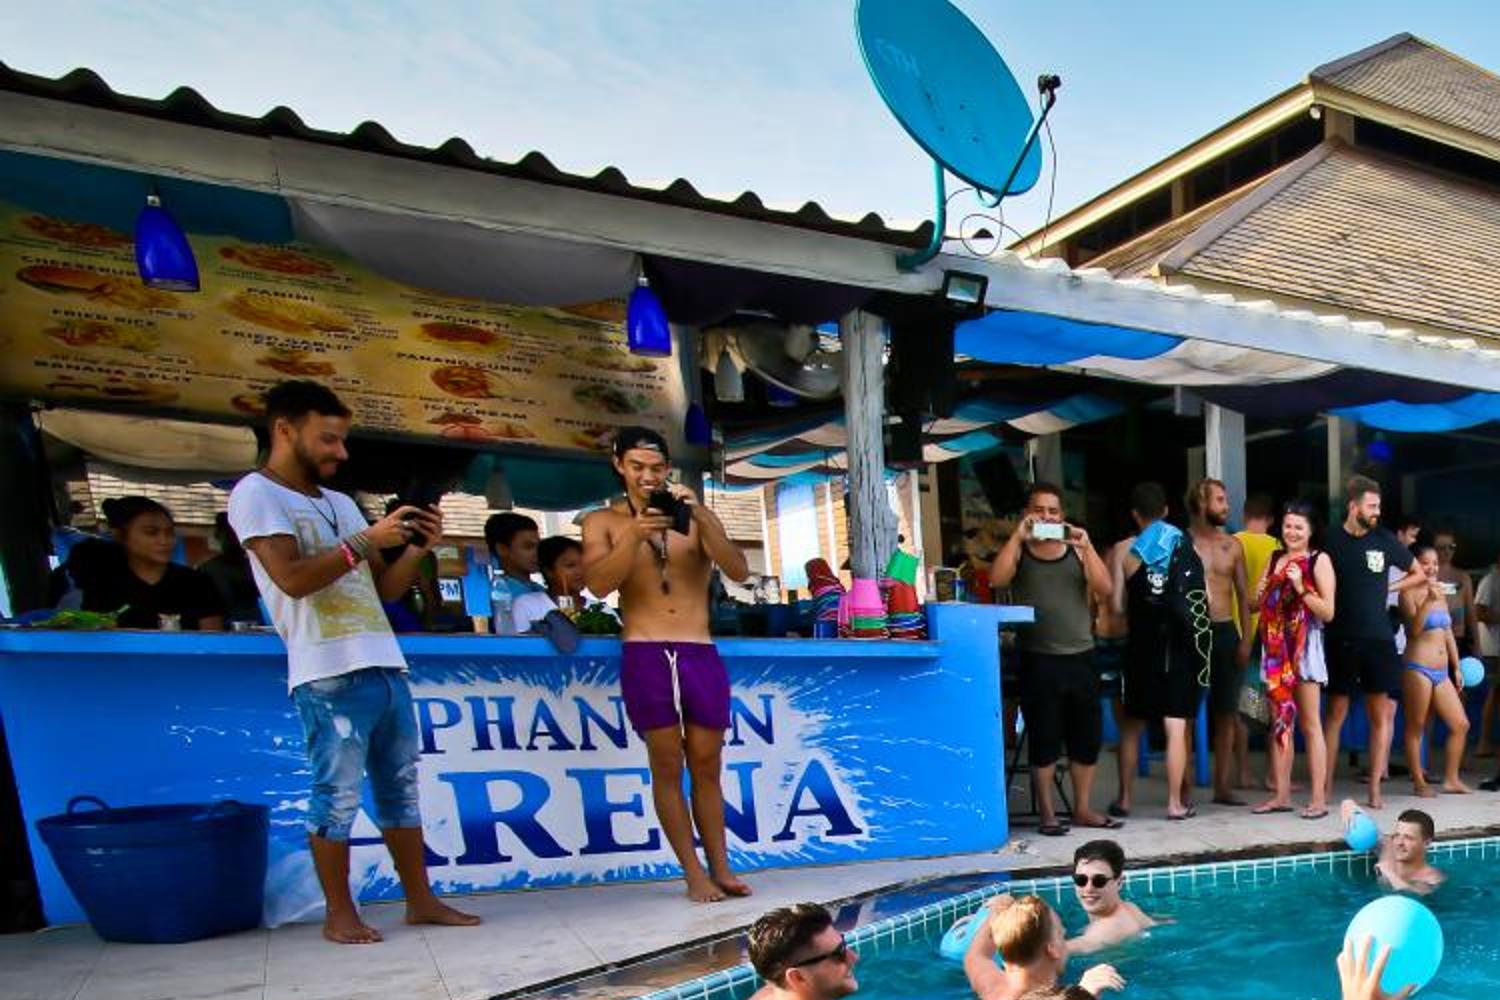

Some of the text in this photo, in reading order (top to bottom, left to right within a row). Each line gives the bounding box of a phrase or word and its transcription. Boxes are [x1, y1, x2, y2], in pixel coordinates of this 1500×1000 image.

[247, 287, 316, 302] PANINI
[113, 315, 156, 328] RICE
[411, 310, 511, 330] SPAGHETTI
[462, 406, 528, 421] CREAM
[416, 693, 776, 755] PHANN
